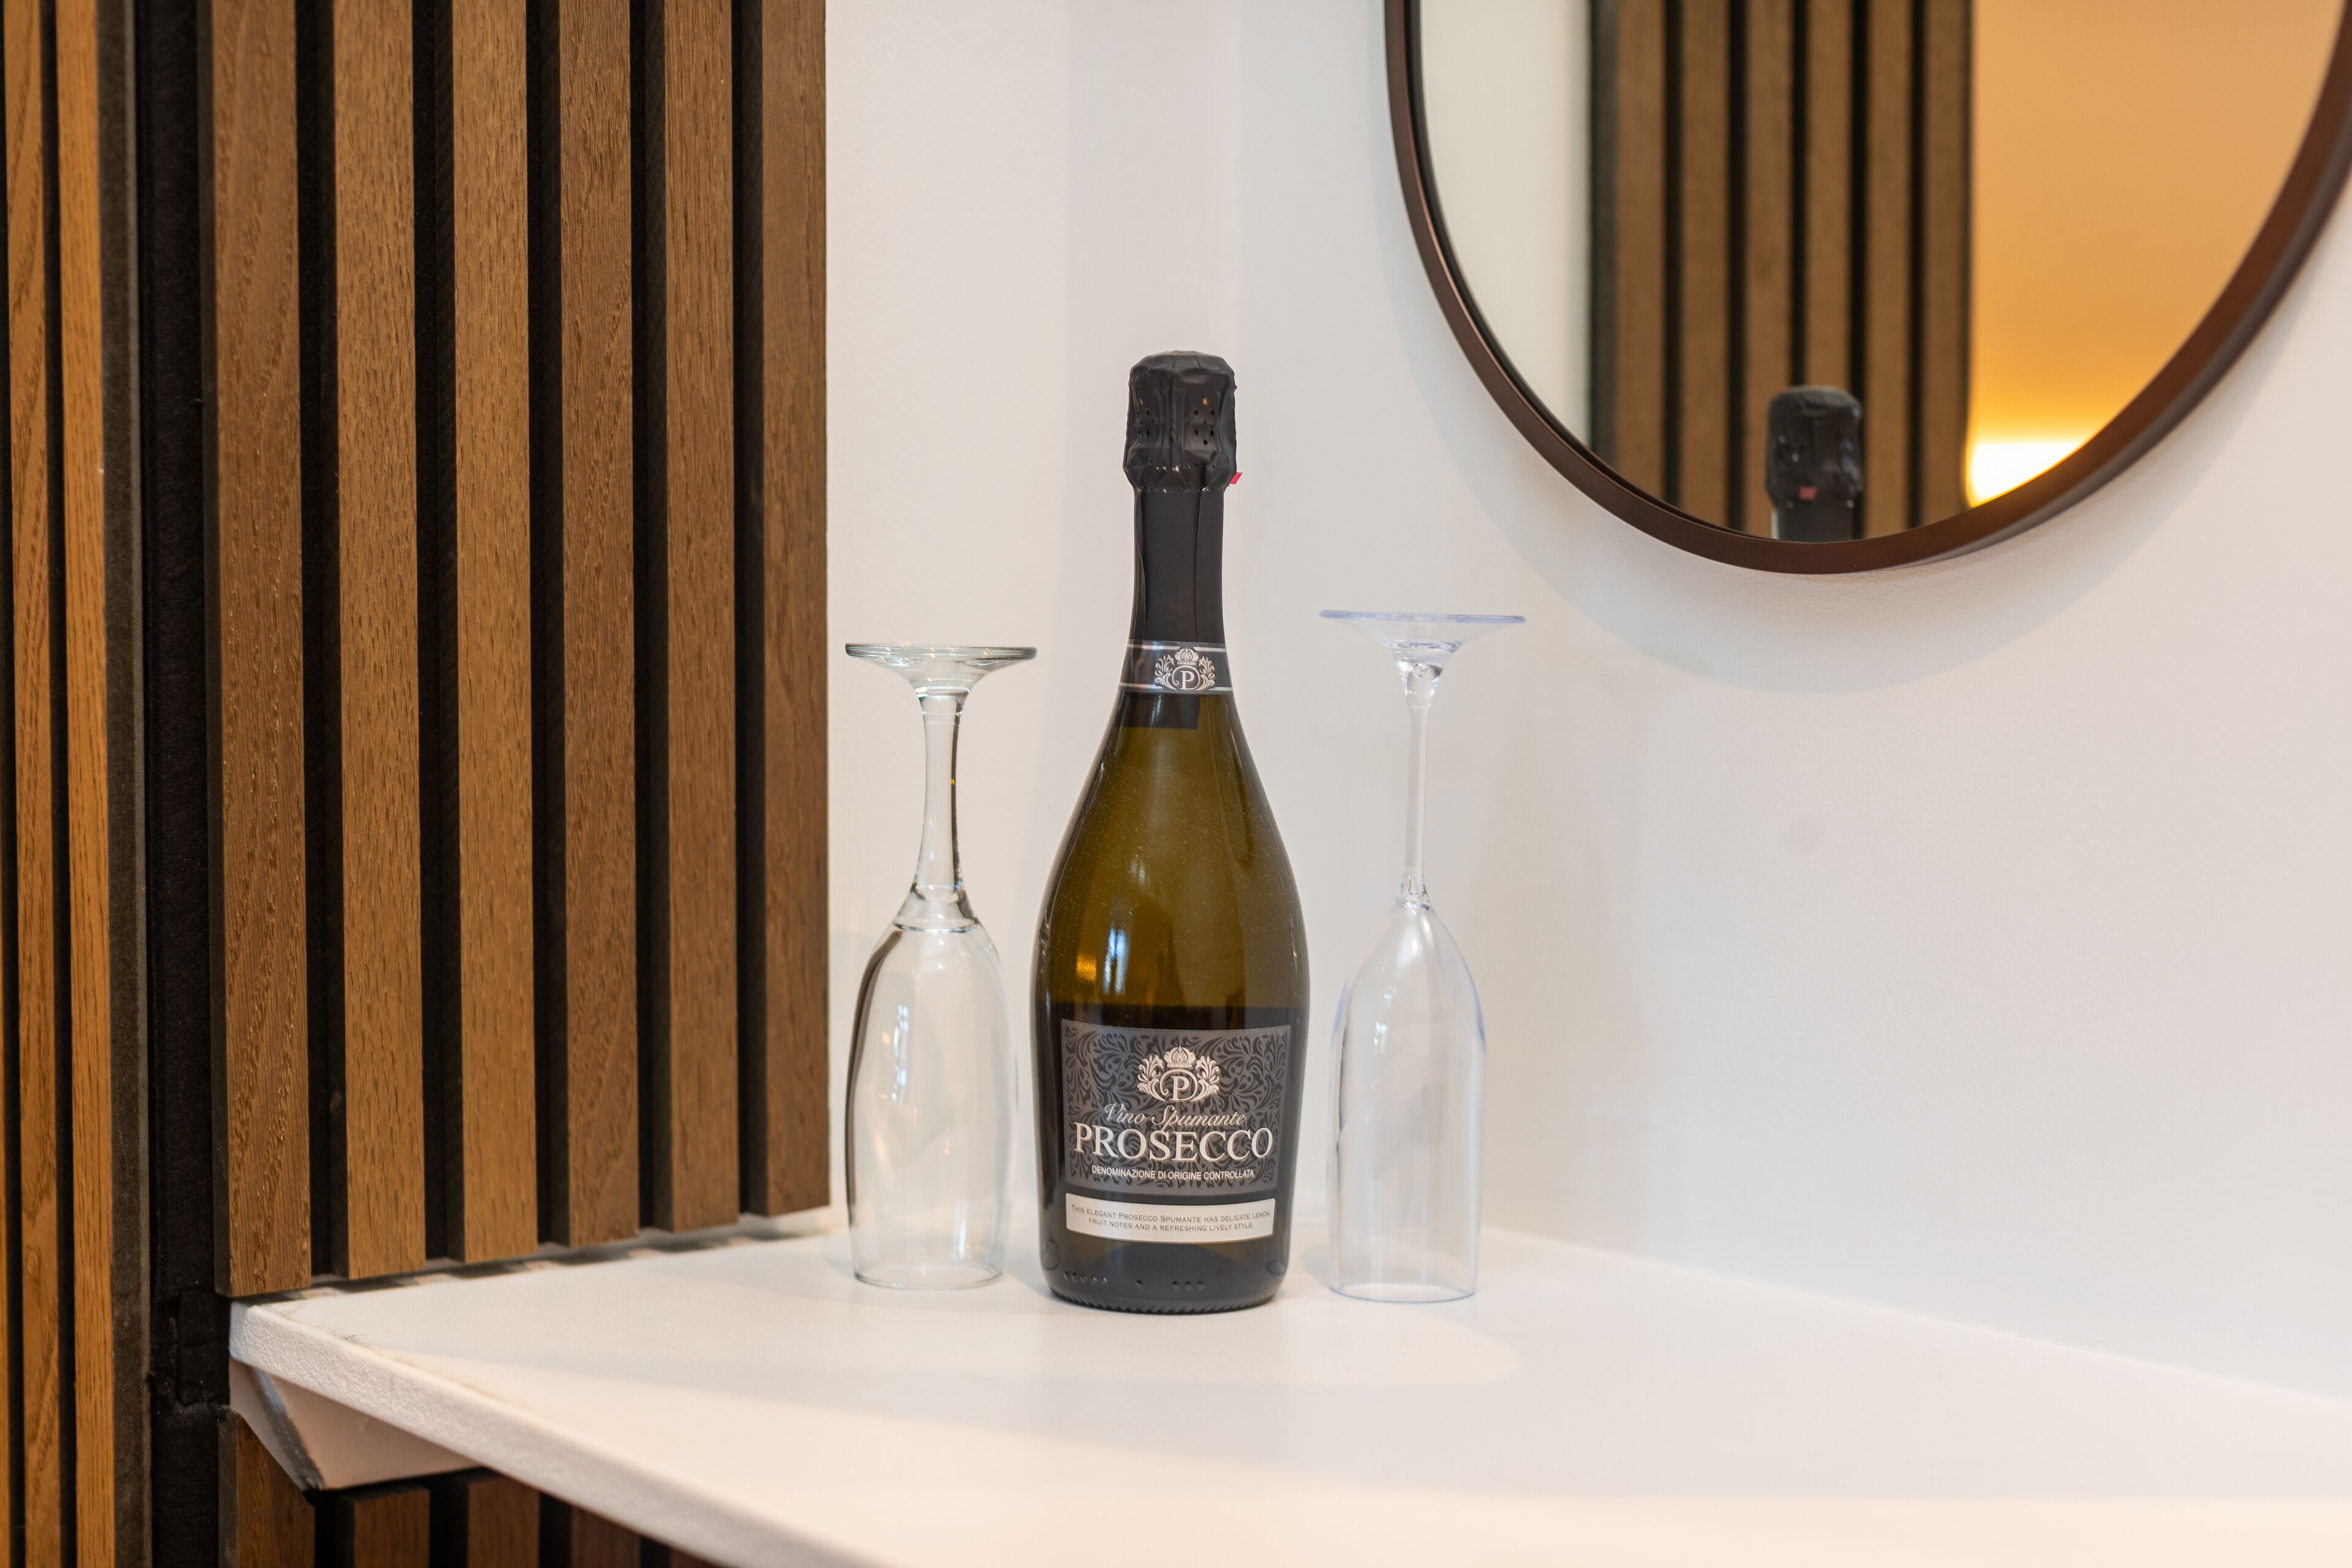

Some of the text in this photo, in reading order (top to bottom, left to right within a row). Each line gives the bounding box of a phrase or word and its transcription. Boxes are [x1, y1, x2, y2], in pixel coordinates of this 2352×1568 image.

[1104, 1102, 1247, 1132] Vino Spumante
[1073, 1121, 1273, 1162] PROSECCO
[1091, 1165, 1254, 1180] DENOMINAZIONE DI ORIGINE CONTROLLATA
[1087, 1208, 1117, 1219] ELEGANT
[1252, 1210, 1270, 1219] LEMON
[1109, 1220, 1133, 1229] NOTES
